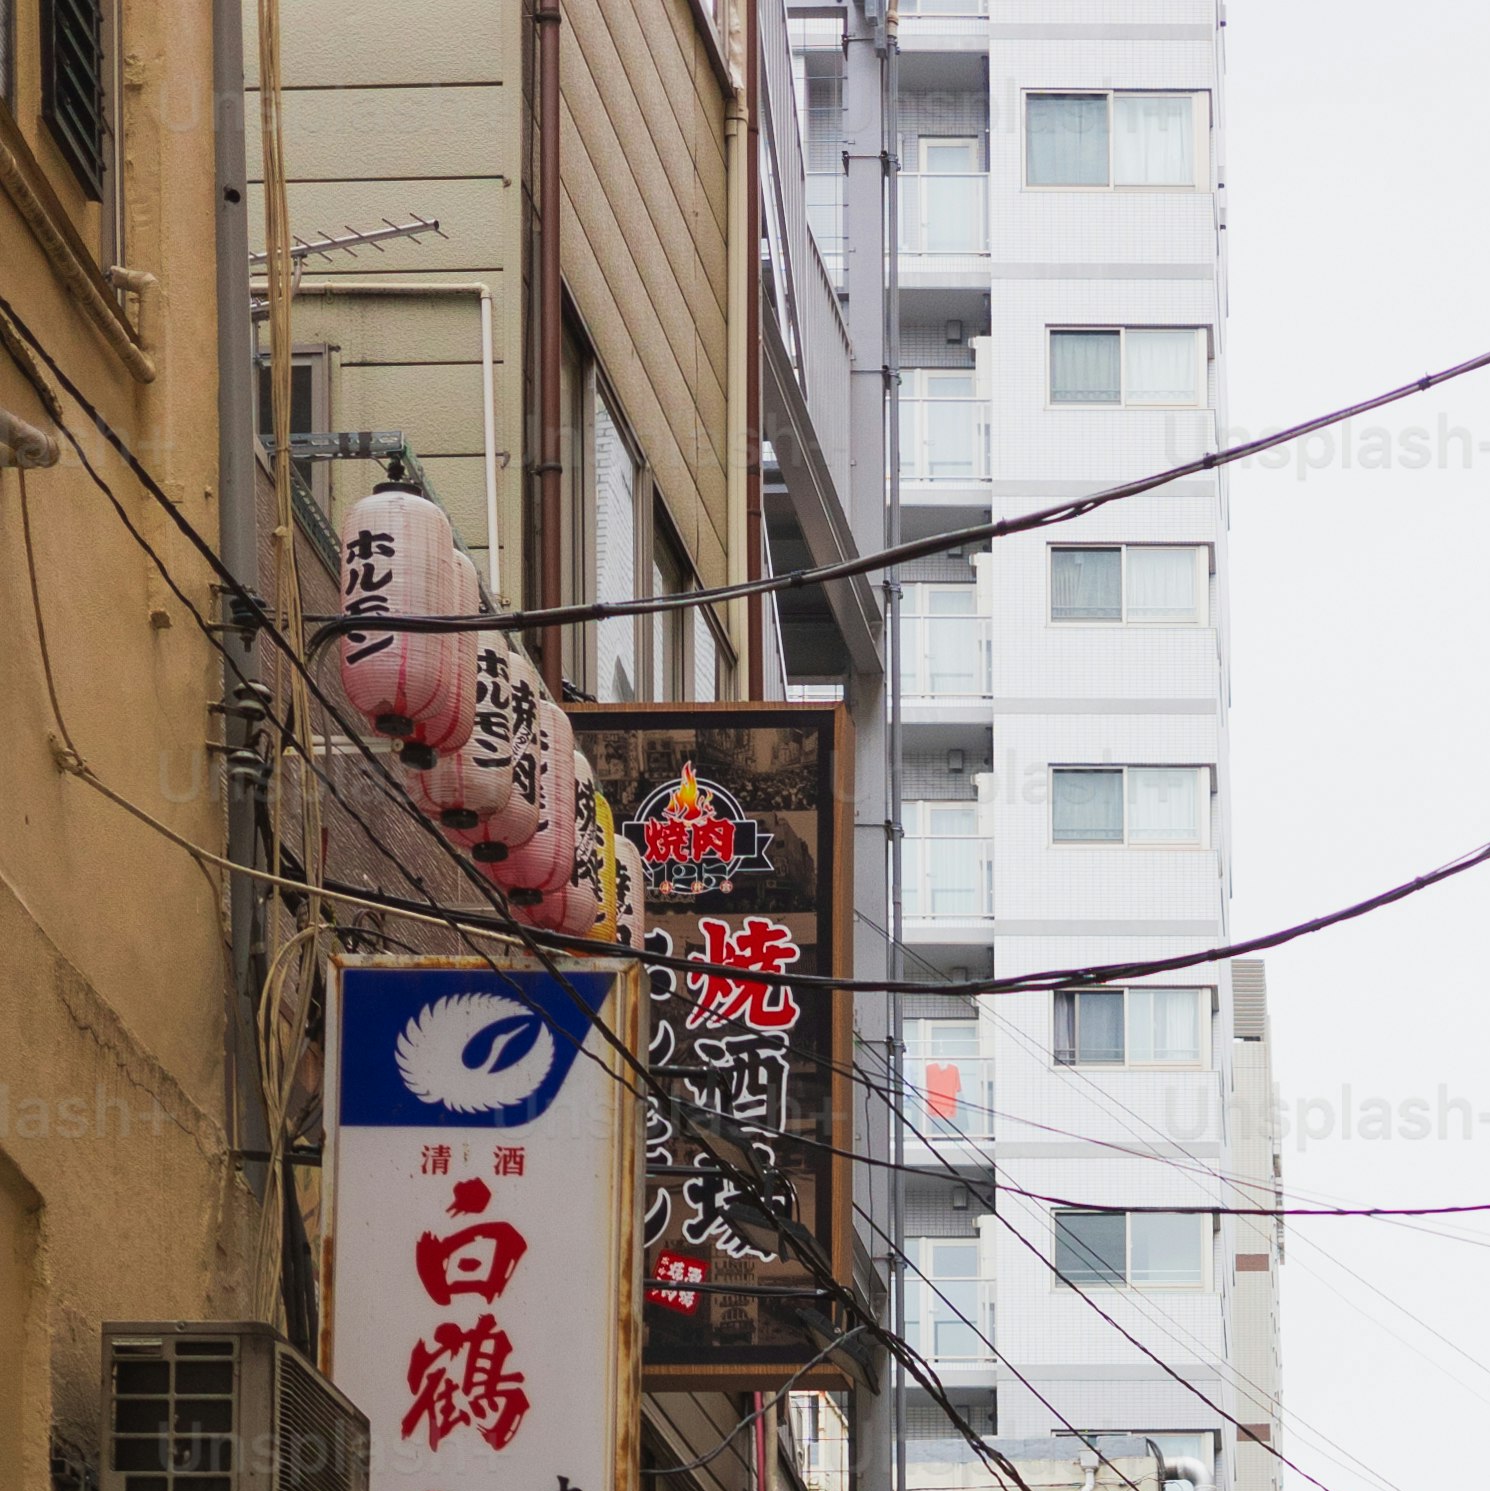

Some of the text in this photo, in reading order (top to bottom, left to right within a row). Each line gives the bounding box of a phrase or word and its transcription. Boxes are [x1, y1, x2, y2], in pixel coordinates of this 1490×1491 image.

[644, 816, 736, 863] 焼肉
[420, 1145, 525, 1177] 清酒
[402, 1177, 530, 1453] 白鶴
